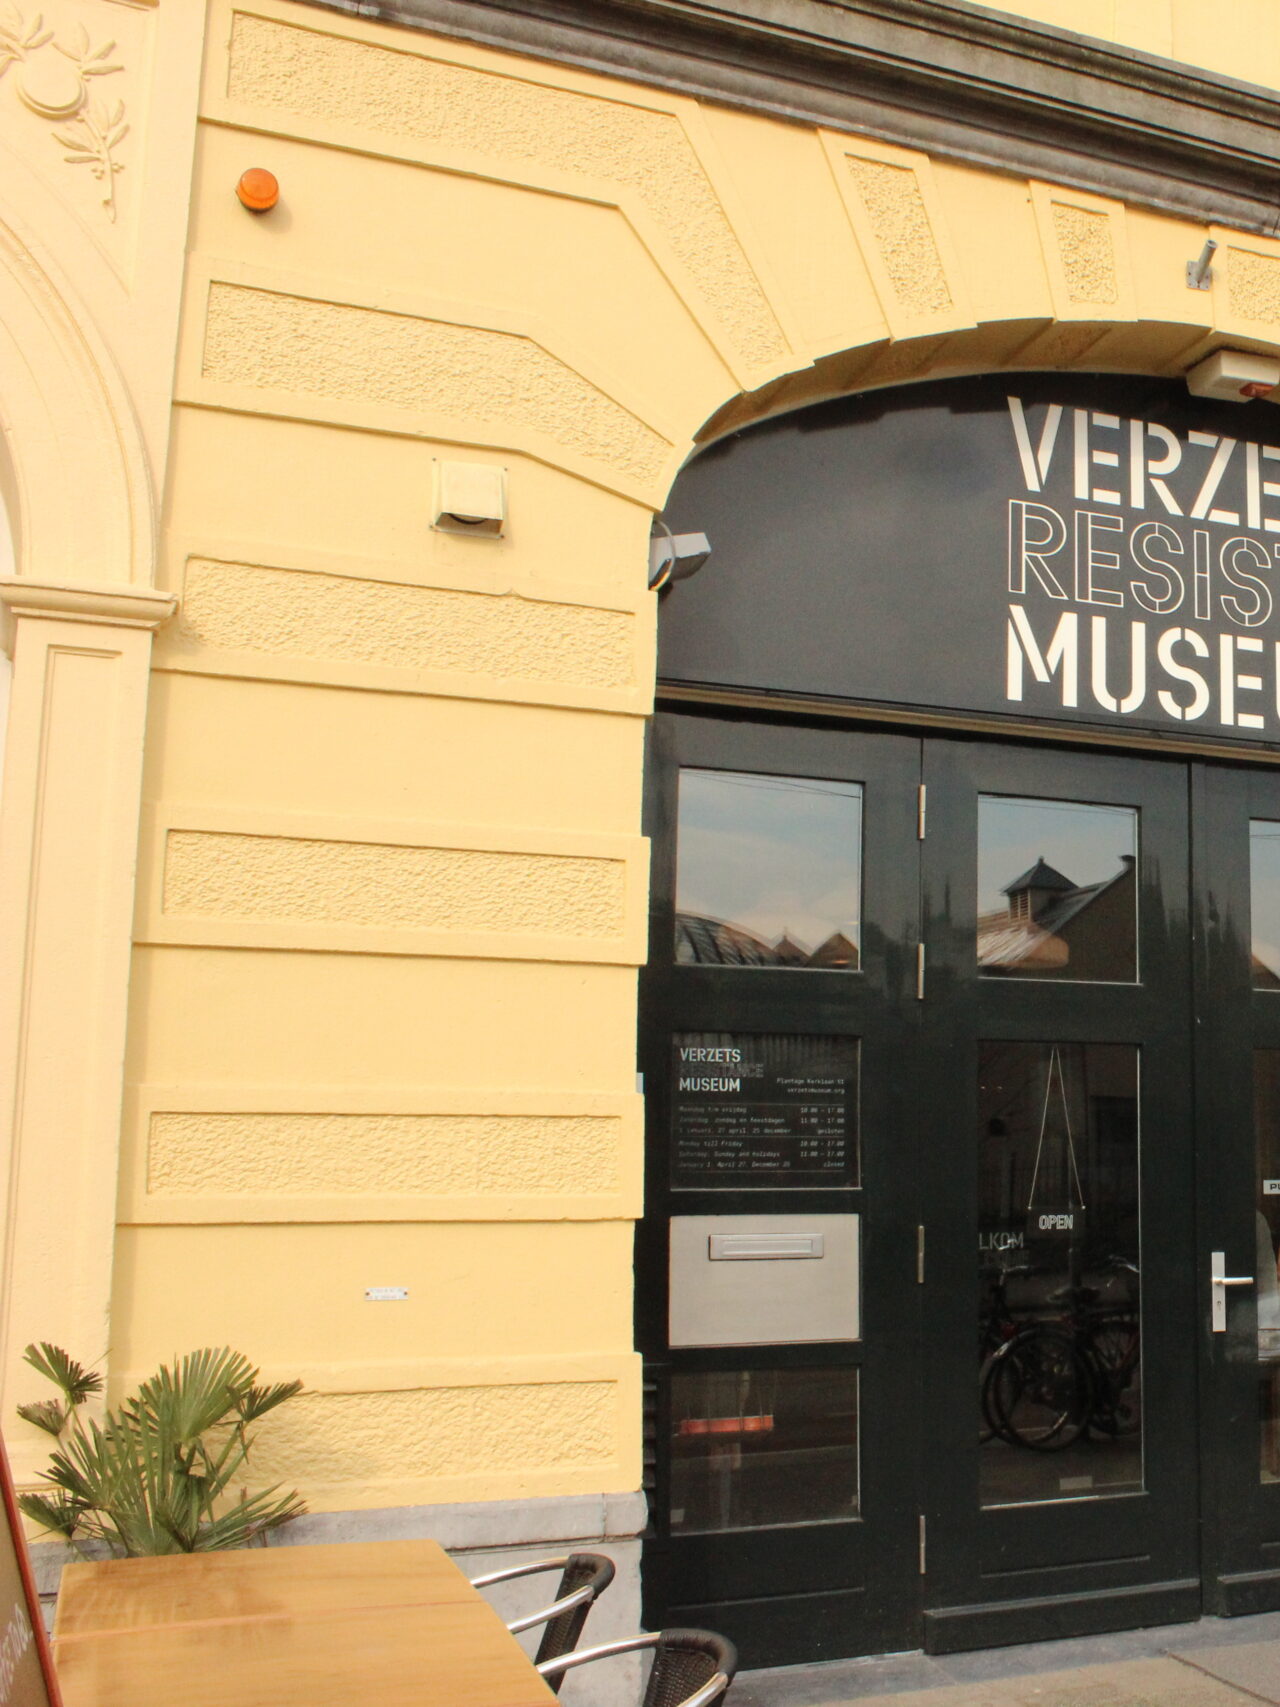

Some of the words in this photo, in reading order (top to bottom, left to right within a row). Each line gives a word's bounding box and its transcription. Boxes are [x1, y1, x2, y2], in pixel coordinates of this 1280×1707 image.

[680, 1047, 741, 1063] VERZETS
[679, 1077, 740, 1092] MUSEUM
[1039, 1214, 1073, 1230] OPEN
